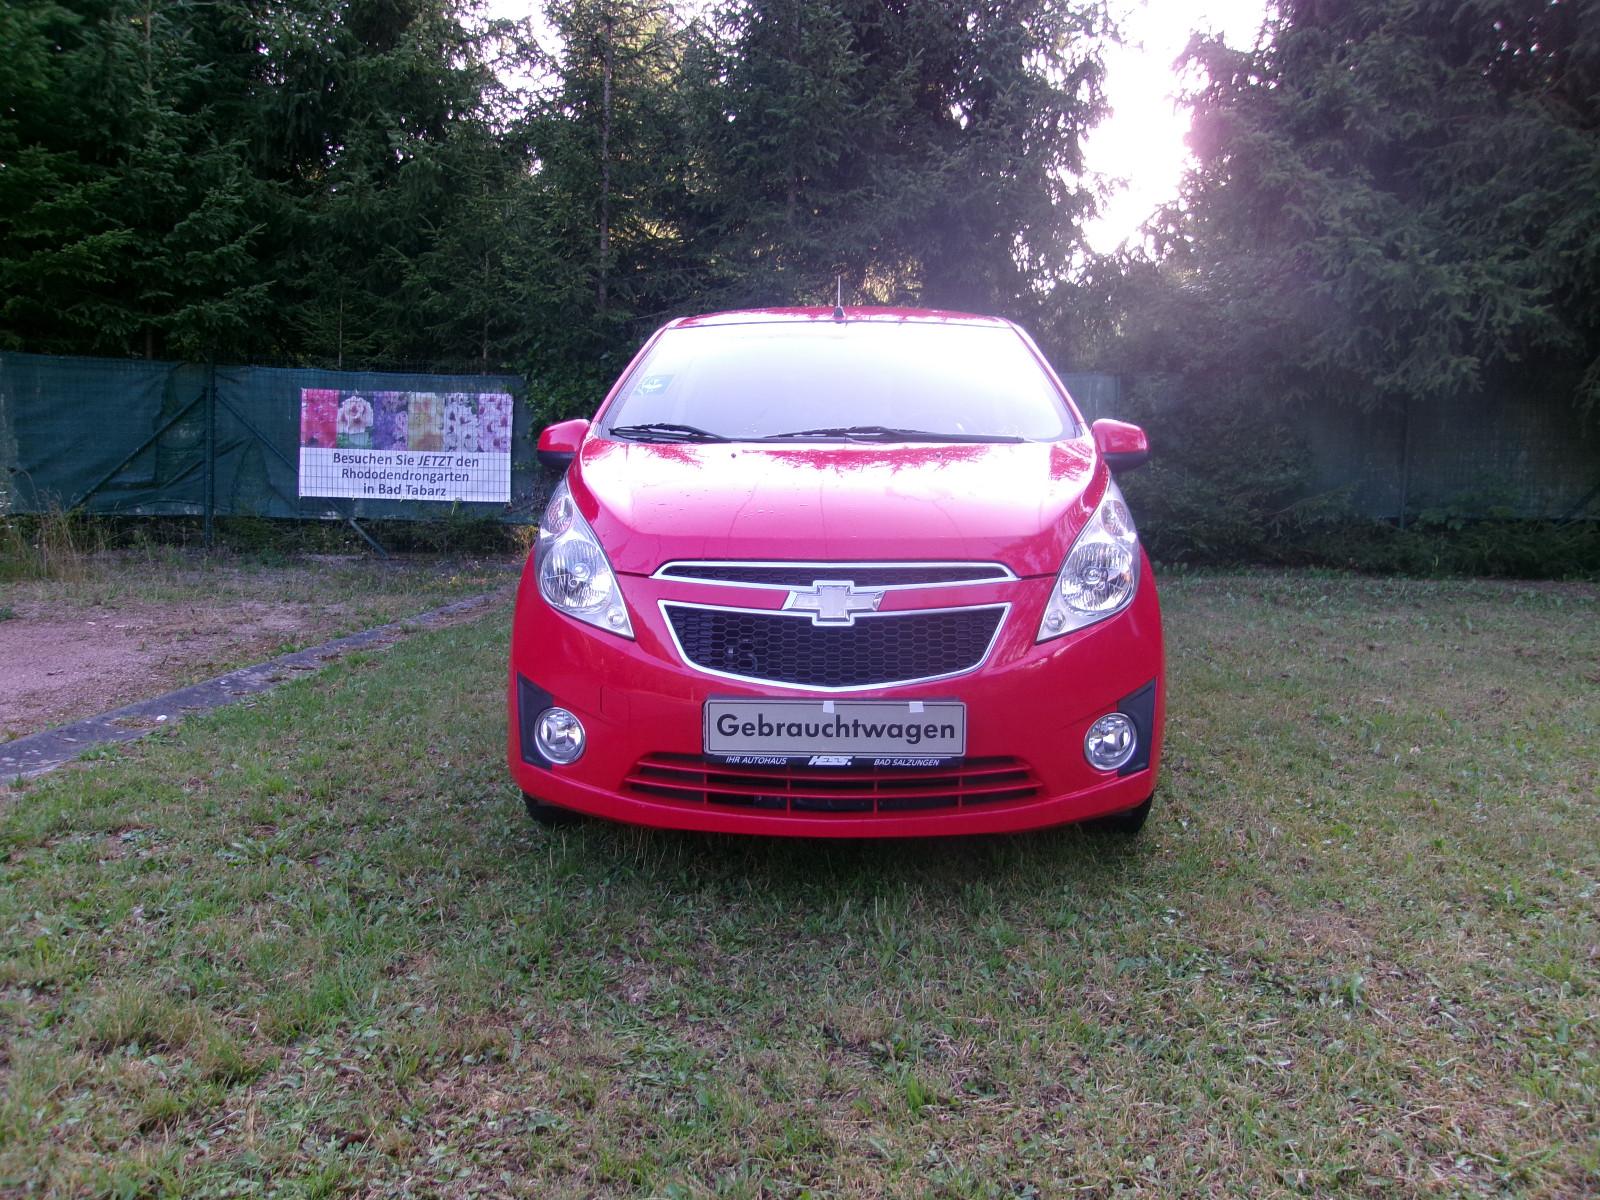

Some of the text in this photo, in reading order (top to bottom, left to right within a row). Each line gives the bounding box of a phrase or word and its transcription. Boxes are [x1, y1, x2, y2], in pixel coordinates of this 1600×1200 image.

[333, 453, 479, 468] Besuchen Sie JETZT den
[341, 468, 469, 483] Rhododendrongarten
[363, 483, 447, 496] in Bad Tabarz
[716, 713, 955, 745] Gebrauchtwagen
[726, 756, 740, 764] IHR
[742, 756, 787, 765] AUTOHAUS
[873, 758, 890, 766] BAD
[891, 758, 940, 767] SALZUNGEN
